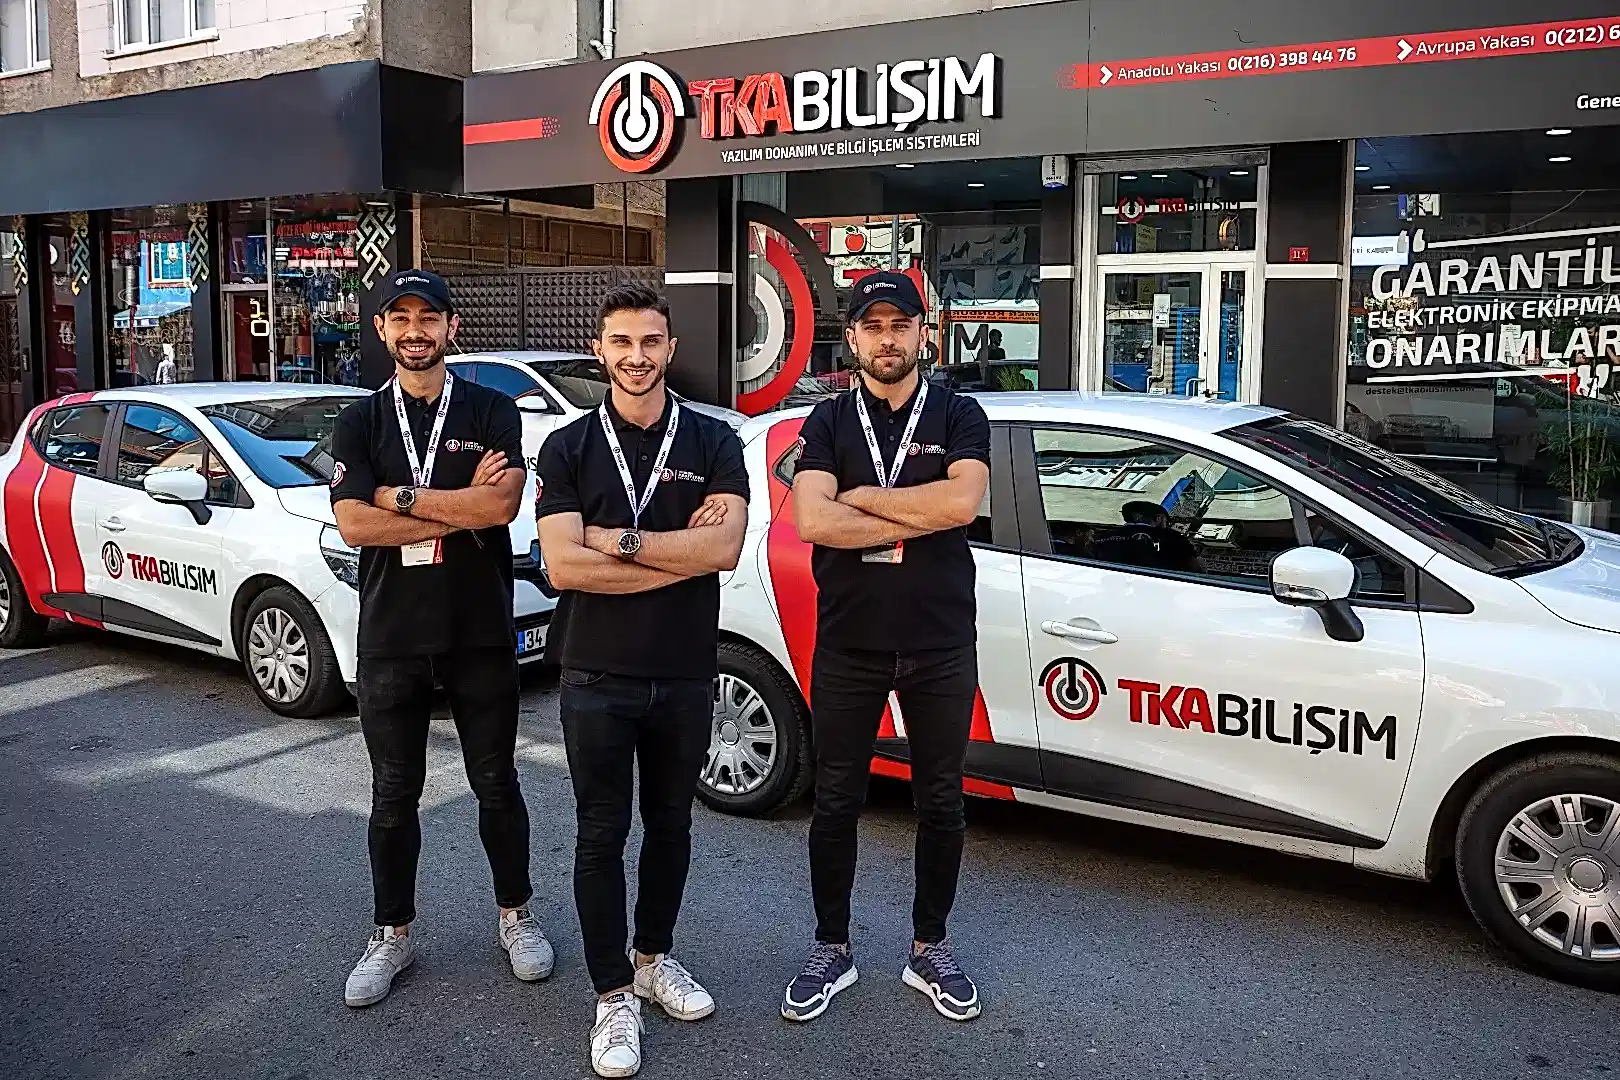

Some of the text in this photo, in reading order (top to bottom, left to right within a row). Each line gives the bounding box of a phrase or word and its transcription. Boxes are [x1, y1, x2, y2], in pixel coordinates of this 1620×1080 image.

[1416, 24, 1620, 56] Avrupa Yakası 0(212) 6
[1118, 47, 1357, 80] Anadolu Yakası 0(216) 398 44 76
[1576, 94, 1620, 110] Gene
[721, 148, 763, 163] YAZILIM
[765, 145, 818, 160] DONANIM
[820, 143, 834, 156] VE
[837, 139, 866, 155] BİLGİ
[868, 137, 904, 156] İŞLEM
[1368, 298, 1516, 328] ELEKTRONİK
[1365, 324, 1620, 369] ONARIMLAR
[526, 628, 543, 649] 34
